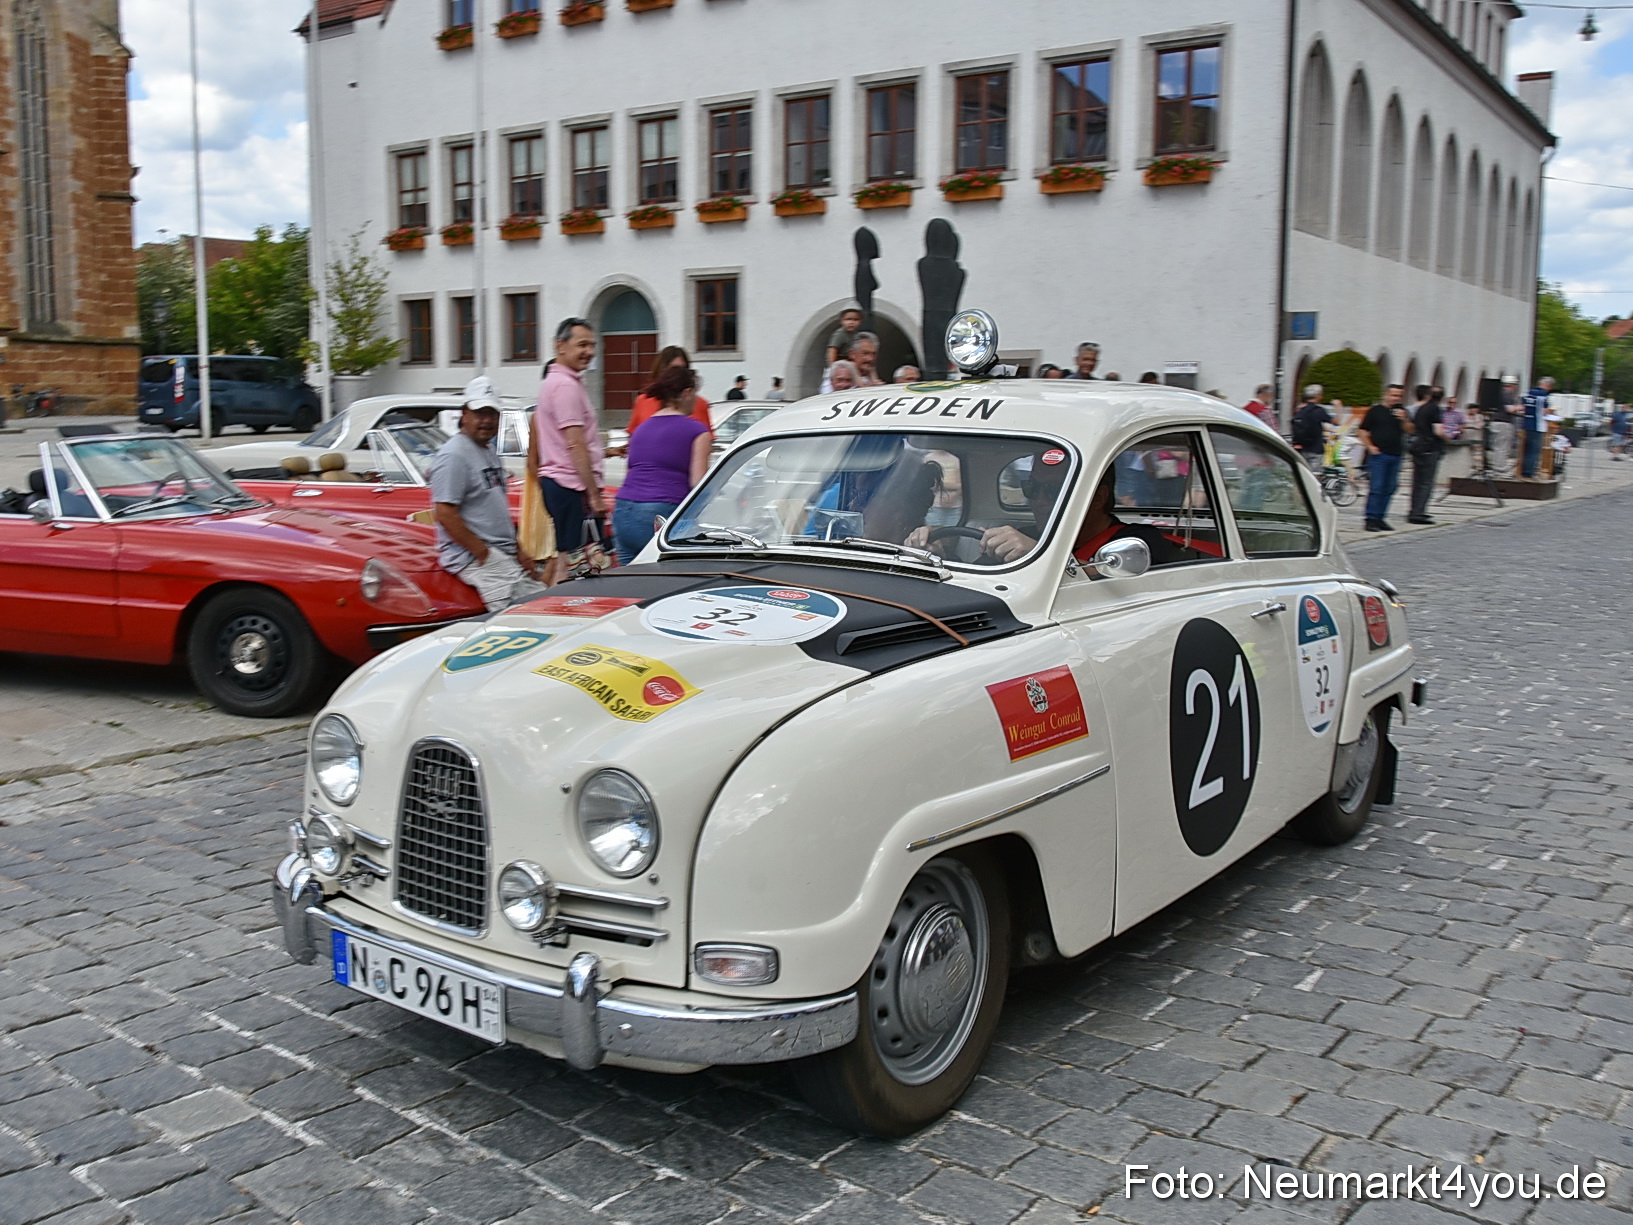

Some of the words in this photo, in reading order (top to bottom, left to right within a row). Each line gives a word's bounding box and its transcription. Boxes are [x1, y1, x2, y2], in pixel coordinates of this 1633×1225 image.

[821, 396, 1004, 421] SWEDEN
[693, 607, 757, 627] 32
[455, 635, 539, 657] BP
[538, 664, 571, 677] EAST
[564, 668, 618, 705] AFRICAN
[610, 698, 656, 721] SAFARI
[1315, 664, 1330, 698] 32
[1008, 721, 1046, 743] Weingut
[1049, 706, 1081, 730] Conrad
[1185, 653, 1250, 809] 21
